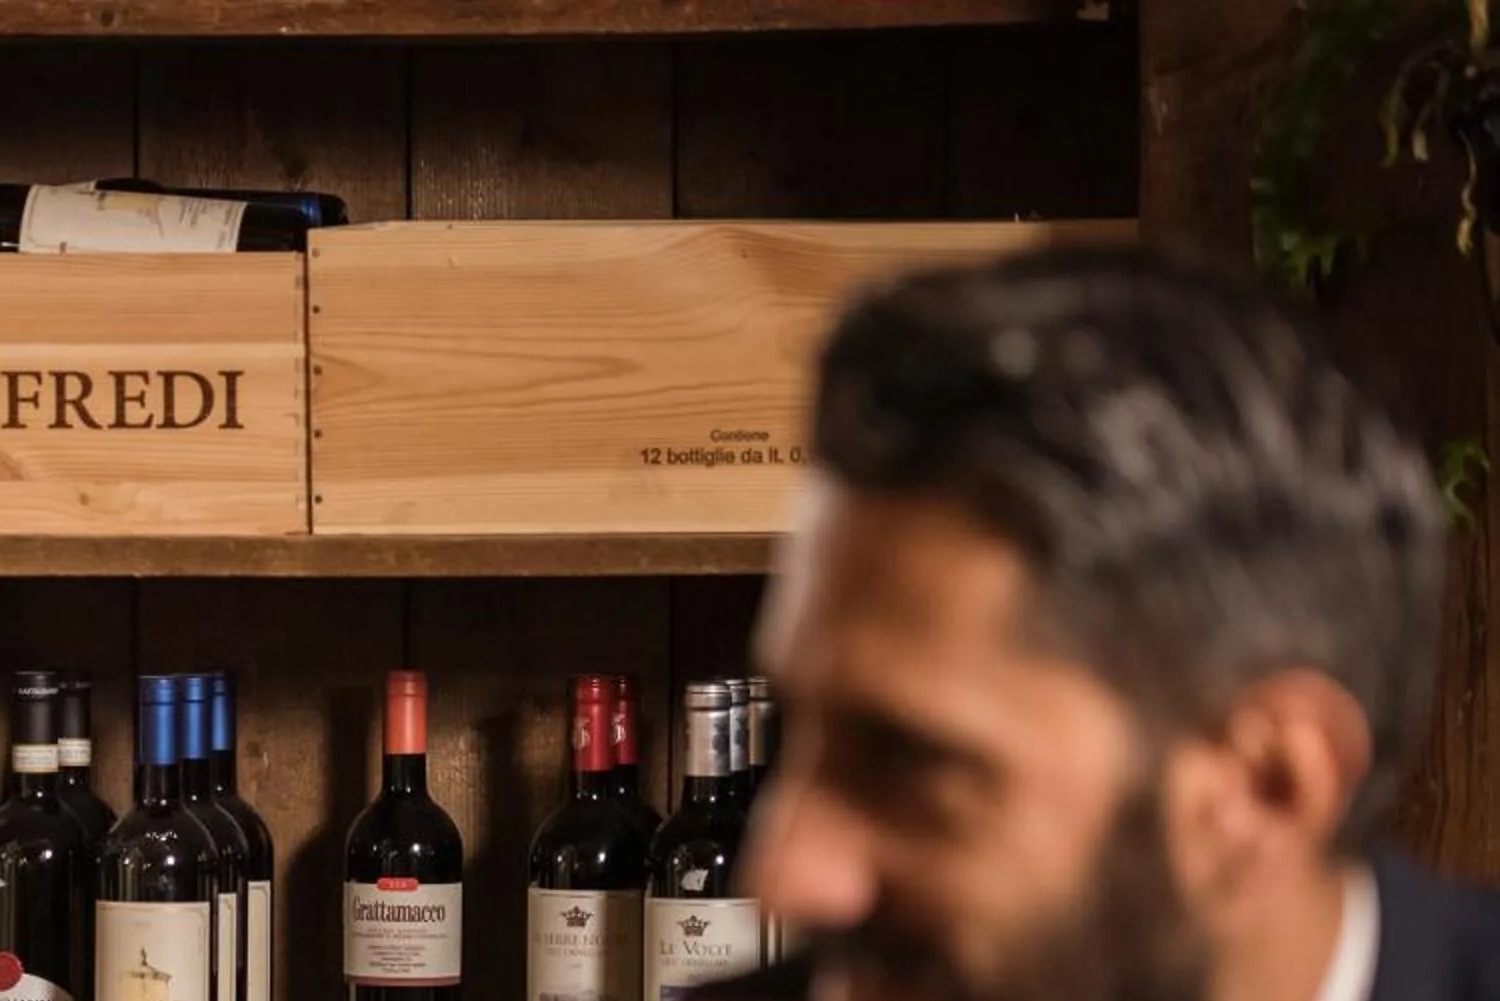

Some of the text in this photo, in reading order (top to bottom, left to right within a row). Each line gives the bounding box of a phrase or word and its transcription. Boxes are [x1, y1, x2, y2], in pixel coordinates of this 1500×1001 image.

[709, 428, 770, 443] Contiene
[640, 447, 662, 465] 12
[666, 446, 736, 468] bottiglie
[740, 446, 763, 464] da
[353, 896, 446, 923] Grattamacco
